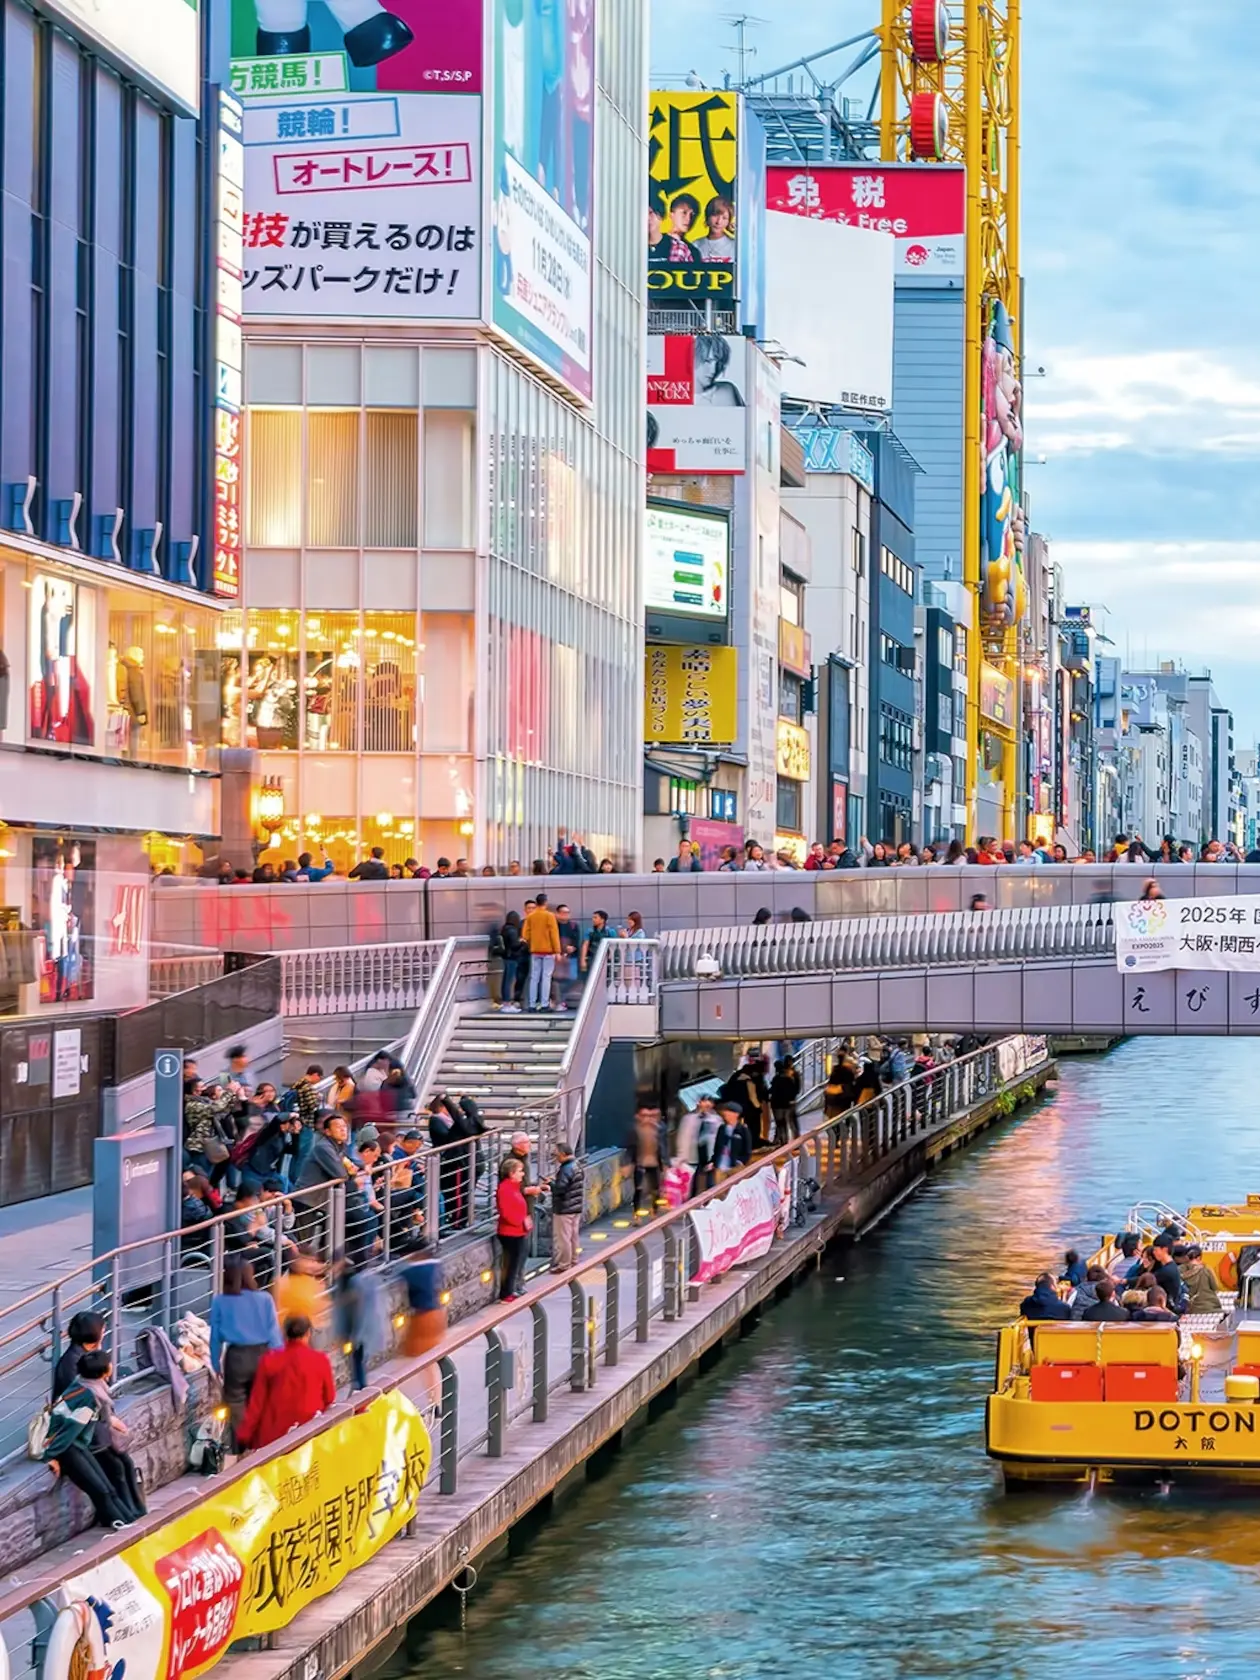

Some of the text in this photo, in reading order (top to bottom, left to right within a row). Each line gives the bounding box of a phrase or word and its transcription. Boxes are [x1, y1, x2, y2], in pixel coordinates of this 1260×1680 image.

[787, 174, 886, 208] 免税
[857, 213, 908, 234] Free
[841, 391, 887, 408] 意匠作成中
[1180, 906, 1247, 925] 2025年
[1131, 942, 1165, 950] EXPO2025
[1133, 1409, 1256, 1433] DOTON
[1174, 1436, 1217, 1451] 大阪
